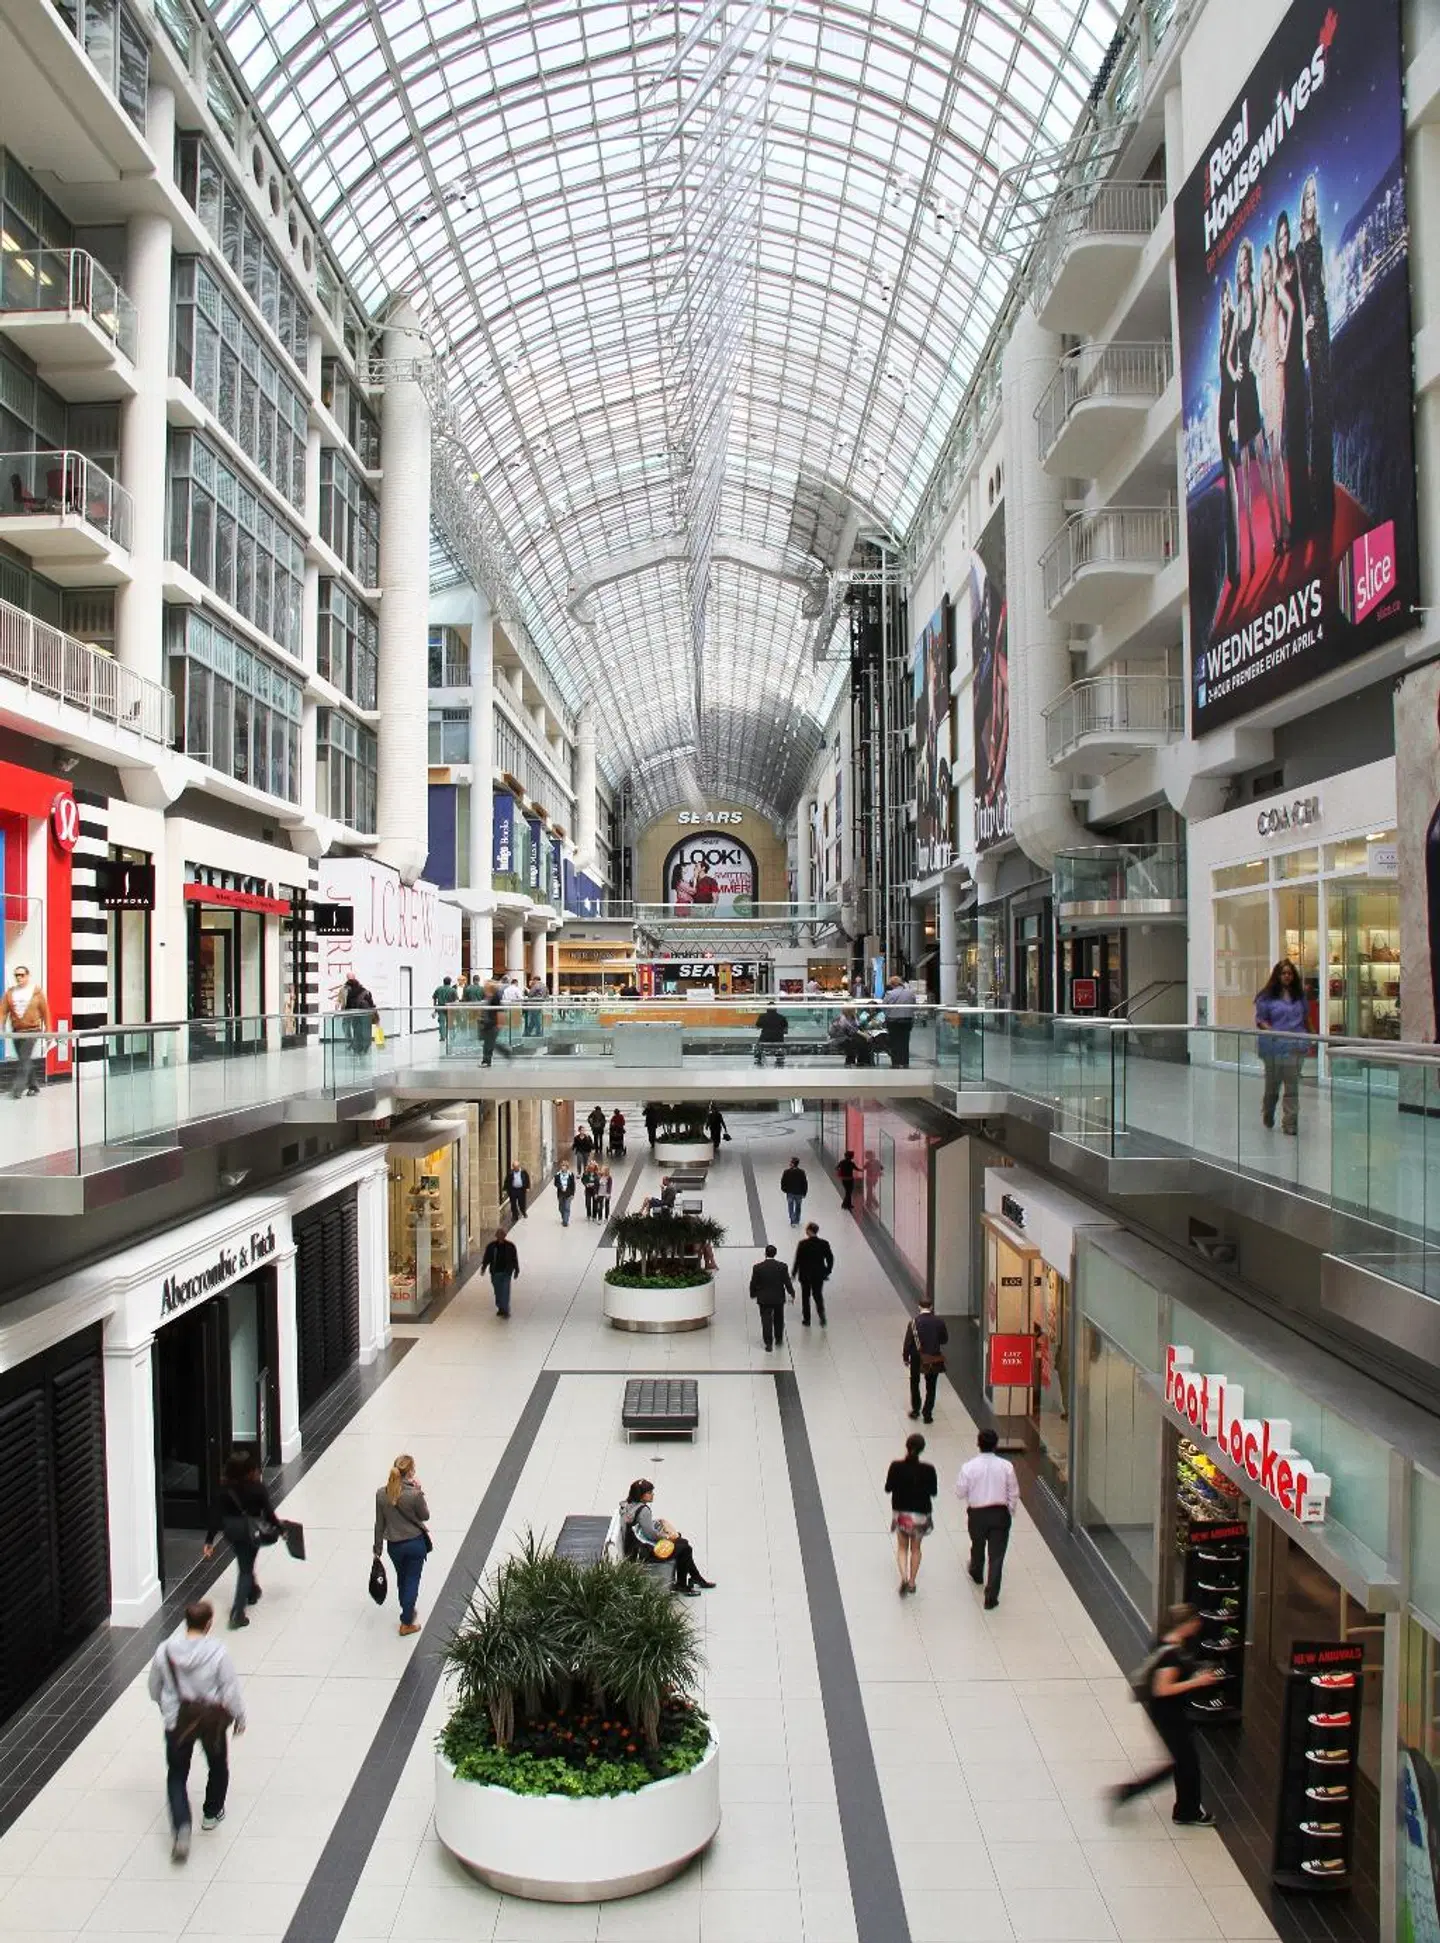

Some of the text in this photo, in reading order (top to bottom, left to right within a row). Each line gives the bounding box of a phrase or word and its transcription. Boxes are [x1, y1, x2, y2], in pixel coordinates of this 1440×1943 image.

[1203, 43, 1325, 252] Housewives
[1208, 98, 1249, 198] Real
[1357, 533, 1391, 609] slice
[1206, 579, 1322, 681] WEDNESDAYS
[1207, 623, 1324, 702] 2-HOUR PREMIERE EVENT APRIL 4
[678, 811, 743, 824] SEARS
[1257, 796, 1320, 836] COACH
[497, 846, 512, 871] Indigo
[680, 849, 742, 866] LOOK!
[680, 965, 744, 978] SEAS
[160, 1224, 276, 1316] Abercrombie & Fitch
[1165, 1345, 1325, 1523] Foot Locker
[1293, 1648, 1362, 1664] NEW ARRIVALS
